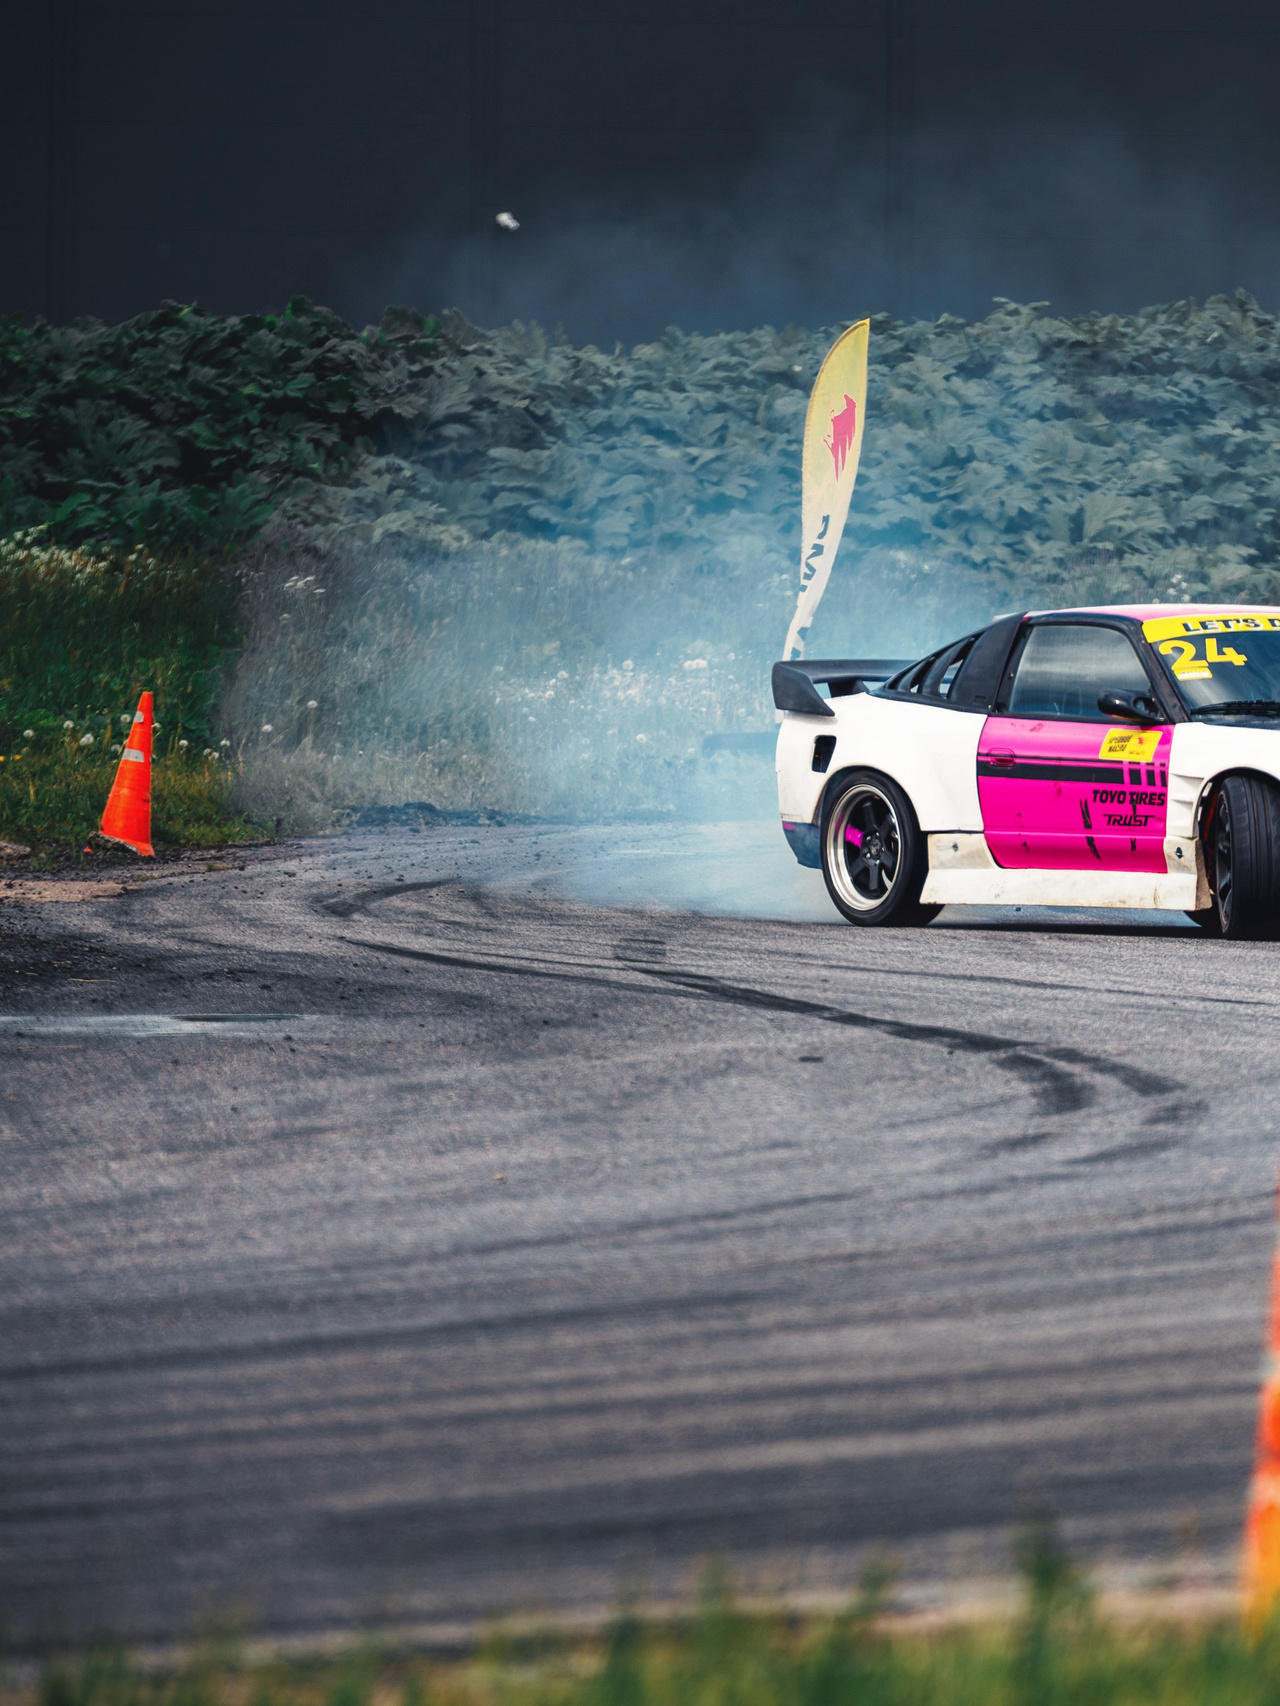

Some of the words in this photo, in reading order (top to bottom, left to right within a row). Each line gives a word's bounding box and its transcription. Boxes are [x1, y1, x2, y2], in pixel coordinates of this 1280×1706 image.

[1182, 617, 1262, 633] LET'S
[1158, 638, 1248, 671] 24
[1092, 789, 1127, 804] TOYO
[1129, 791, 1166, 806] TIRES
[1103, 814, 1156, 827] TRUST
